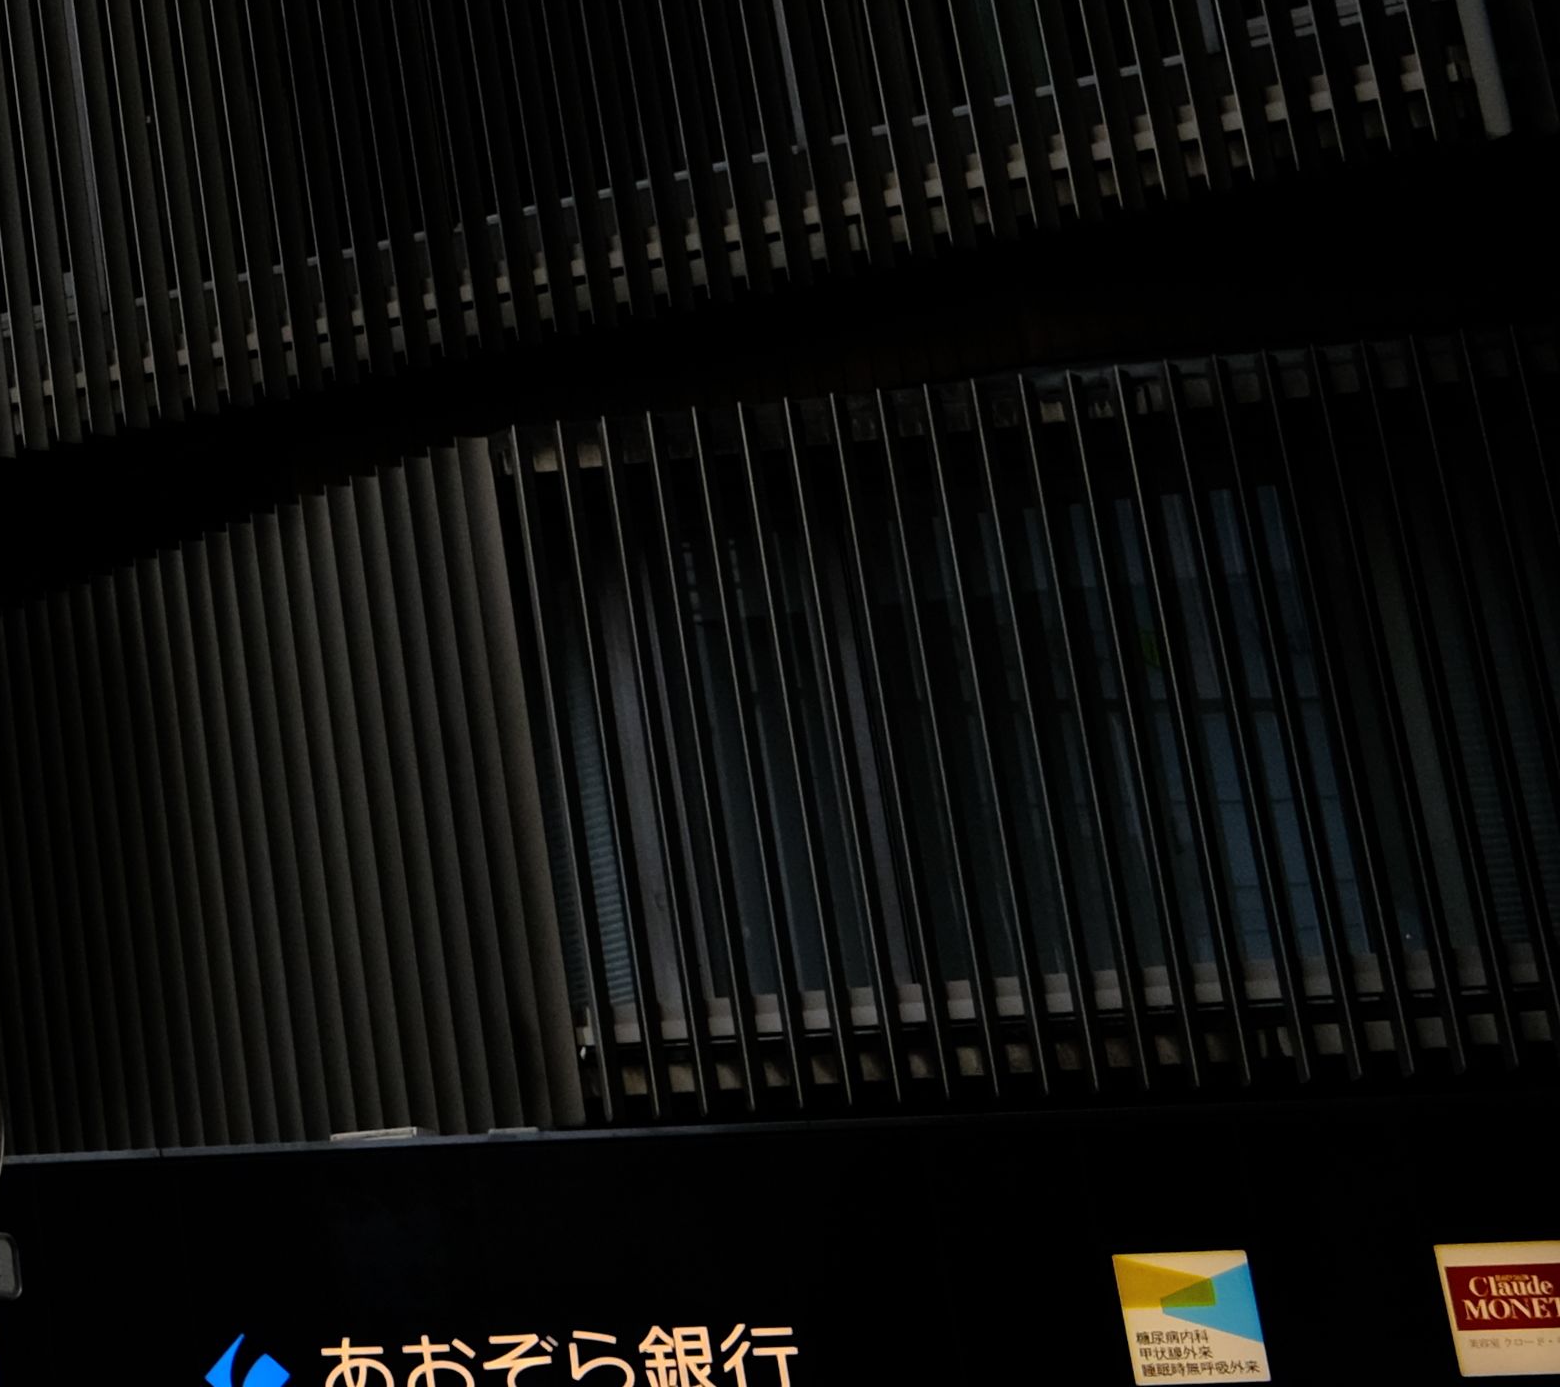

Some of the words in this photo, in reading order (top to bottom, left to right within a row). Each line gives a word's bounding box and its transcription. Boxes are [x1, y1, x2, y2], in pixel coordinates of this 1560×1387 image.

[1468, 1274, 1554, 1297] Claude
[1135, 1330, 1209, 1345] 糖尿病内科
[1504, 1337, 1560, 1347] クロード・
[320, 1323, 799, 1387] あおぞら銀行
[1139, 1345, 1214, 1361] 甲状腺外来
[1141, 1360, 1261, 1377] 睡眠時無呼吸外来
